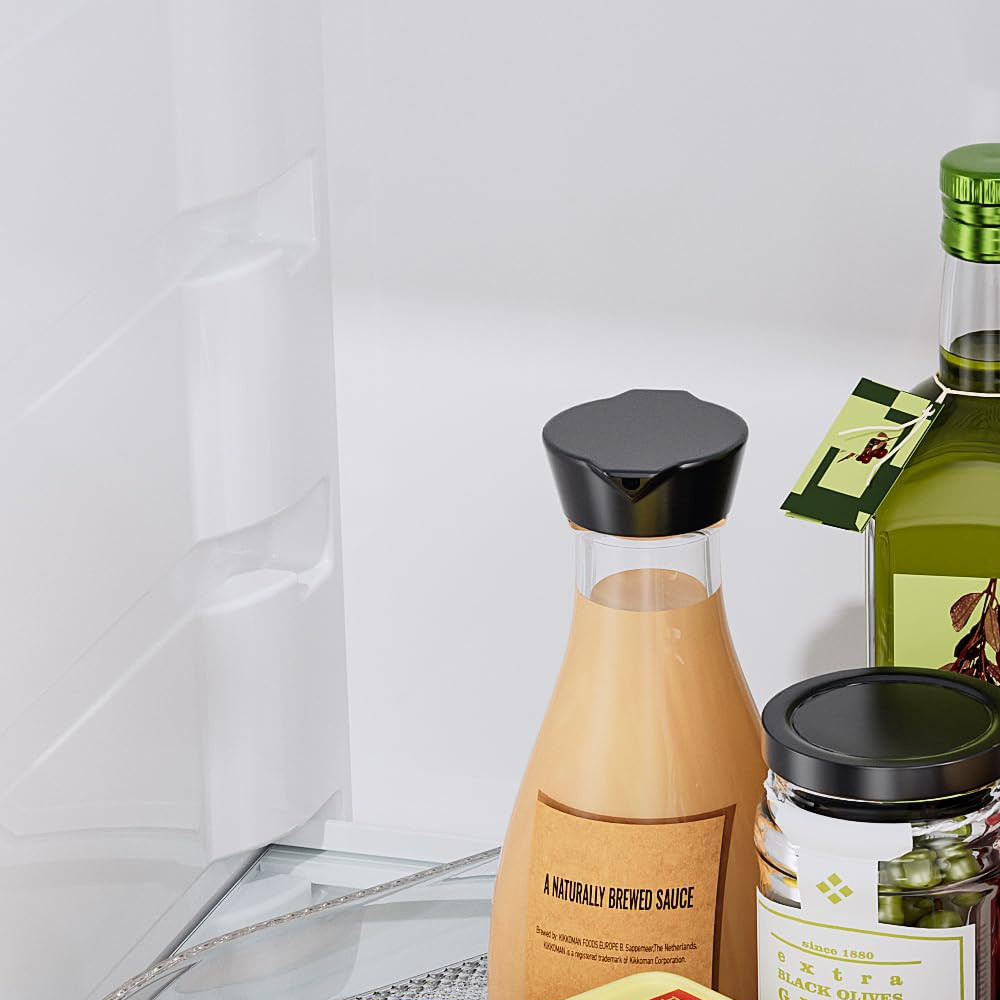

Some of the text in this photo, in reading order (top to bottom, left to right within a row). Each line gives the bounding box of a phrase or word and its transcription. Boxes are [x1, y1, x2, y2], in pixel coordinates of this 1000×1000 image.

[544, 873, 694, 910] A NATURALLY BREWED SAUCE
[536, 925, 551, 938] Brewed
[558, 934, 582, 946] KIKKOMAN
[582, 938, 598, 948] FOODS
[599, 941, 618, 951] EUROPE
[802, 941, 874, 960] since 1880
[544, 941, 566, 954] KIKKOMAN
[574, 950, 597, 960] registered
[598, 954, 622, 964] trademark
[624, 956, 628, 964] of
[630, 956, 654, 965] Kikkoman
[778, 968, 832, 997] BLACK
